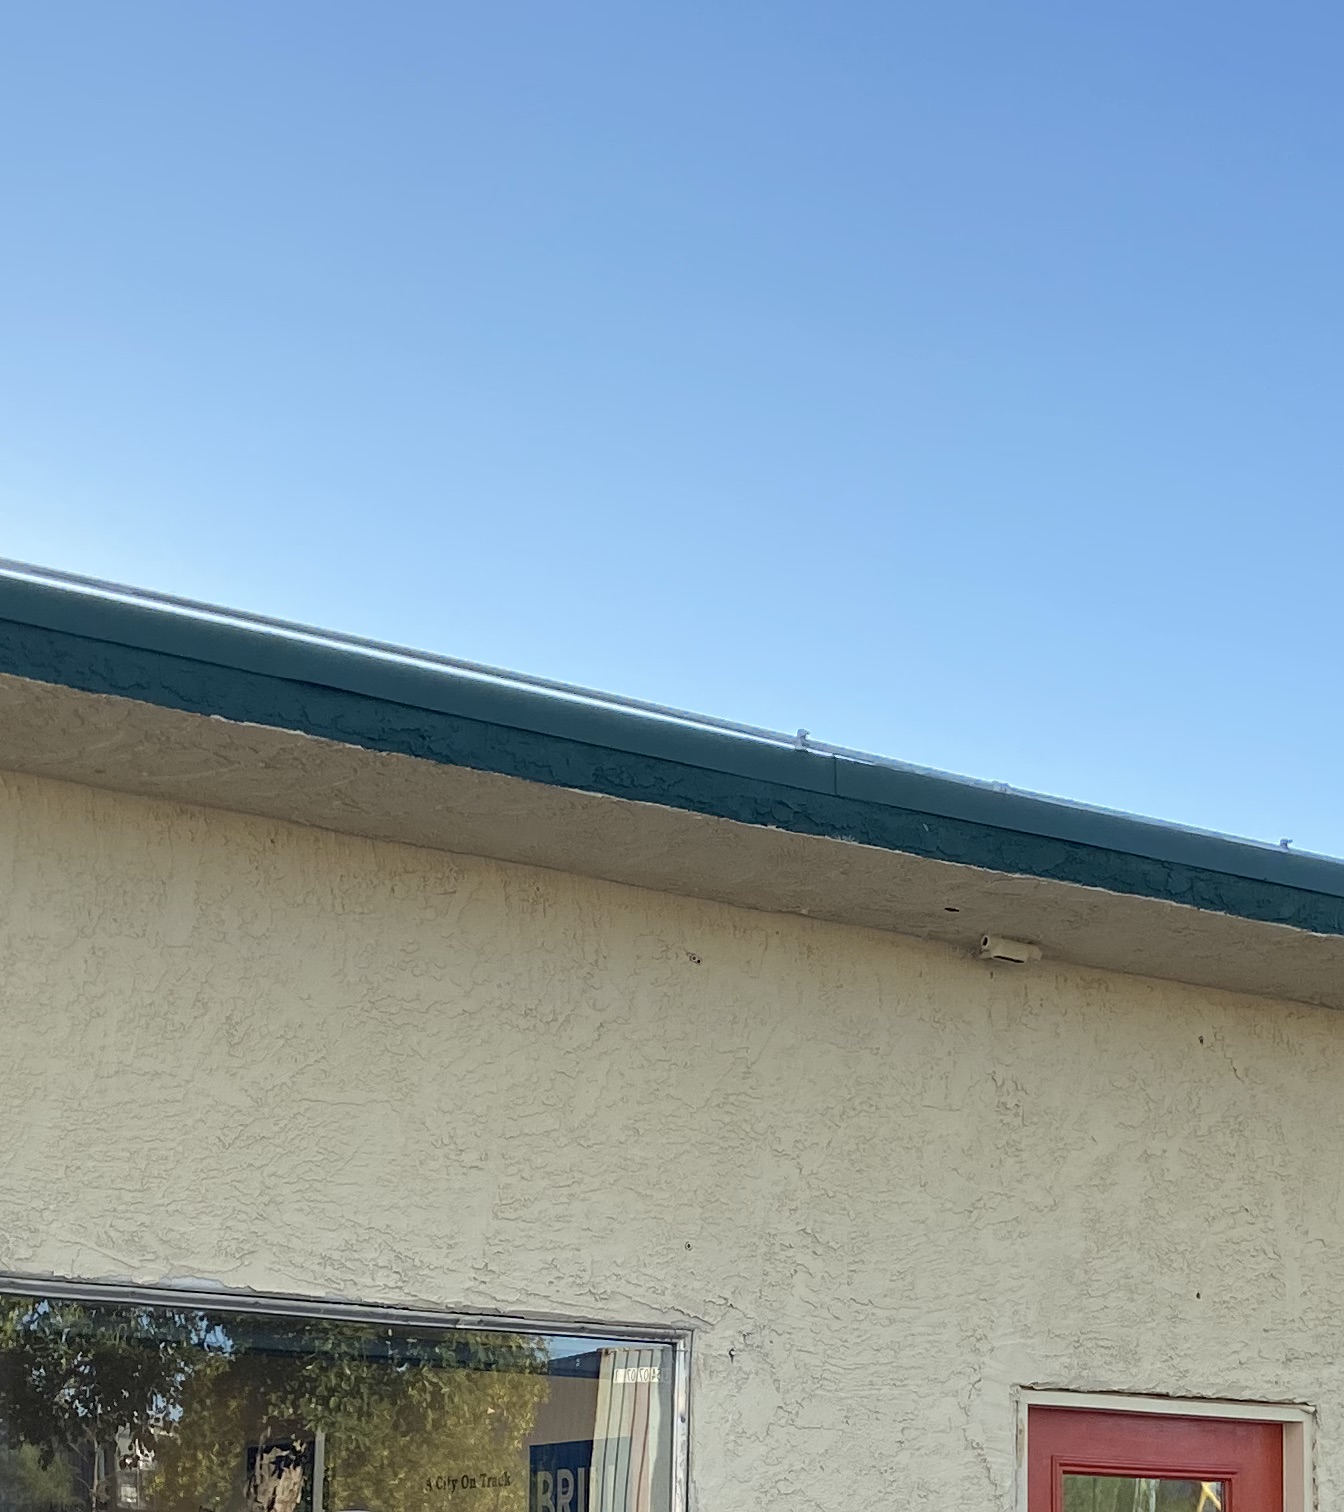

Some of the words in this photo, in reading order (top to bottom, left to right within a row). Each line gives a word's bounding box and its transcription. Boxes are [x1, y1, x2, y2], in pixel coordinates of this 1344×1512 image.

[436, 1475, 458, 1493] City
[461, 1474, 477, 1489] On
[479, 1471, 512, 1489] Track
